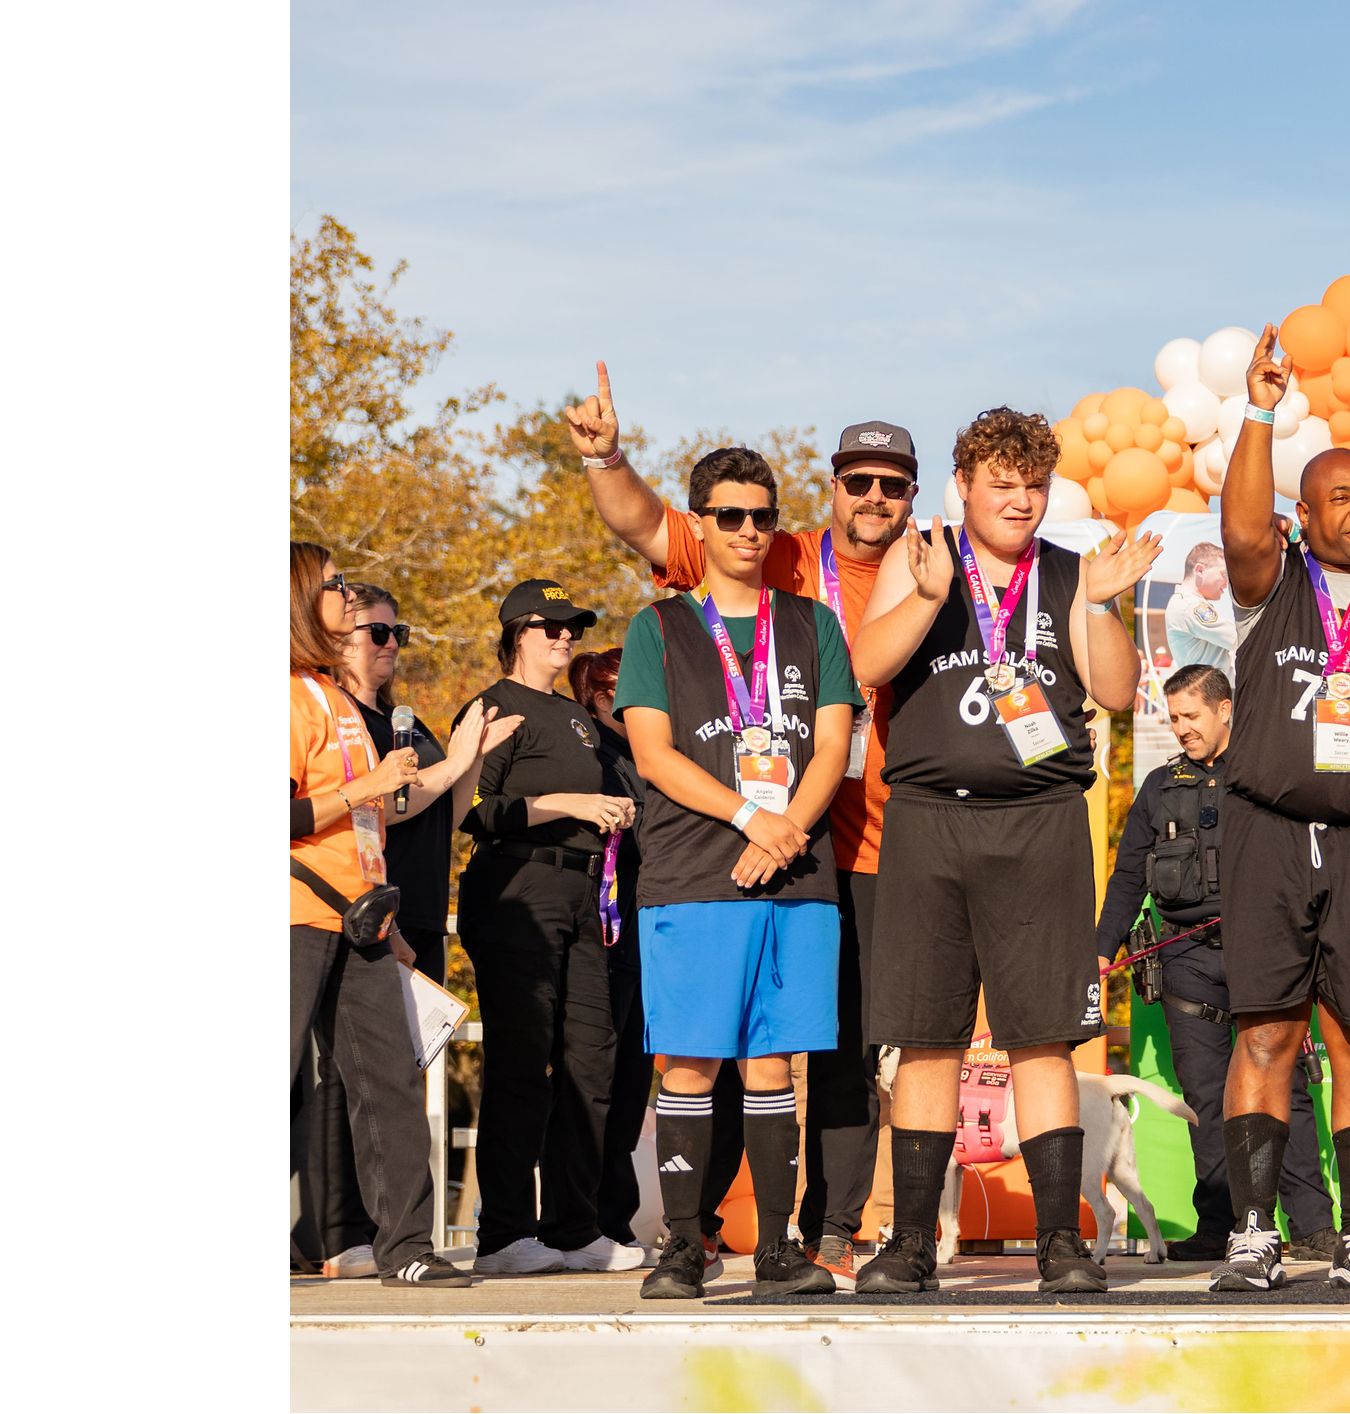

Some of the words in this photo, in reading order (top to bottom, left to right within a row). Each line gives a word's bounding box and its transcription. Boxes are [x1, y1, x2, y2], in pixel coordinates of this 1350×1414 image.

[964, 554, 975, 574] FALL
[970, 574, 984, 605] GAMES
[712, 622, 724, 646] FALL
[721, 646, 740, 678] GAMES
[929, 649, 979, 674] TEAM
[1275, 646, 1316, 666] TEAM
